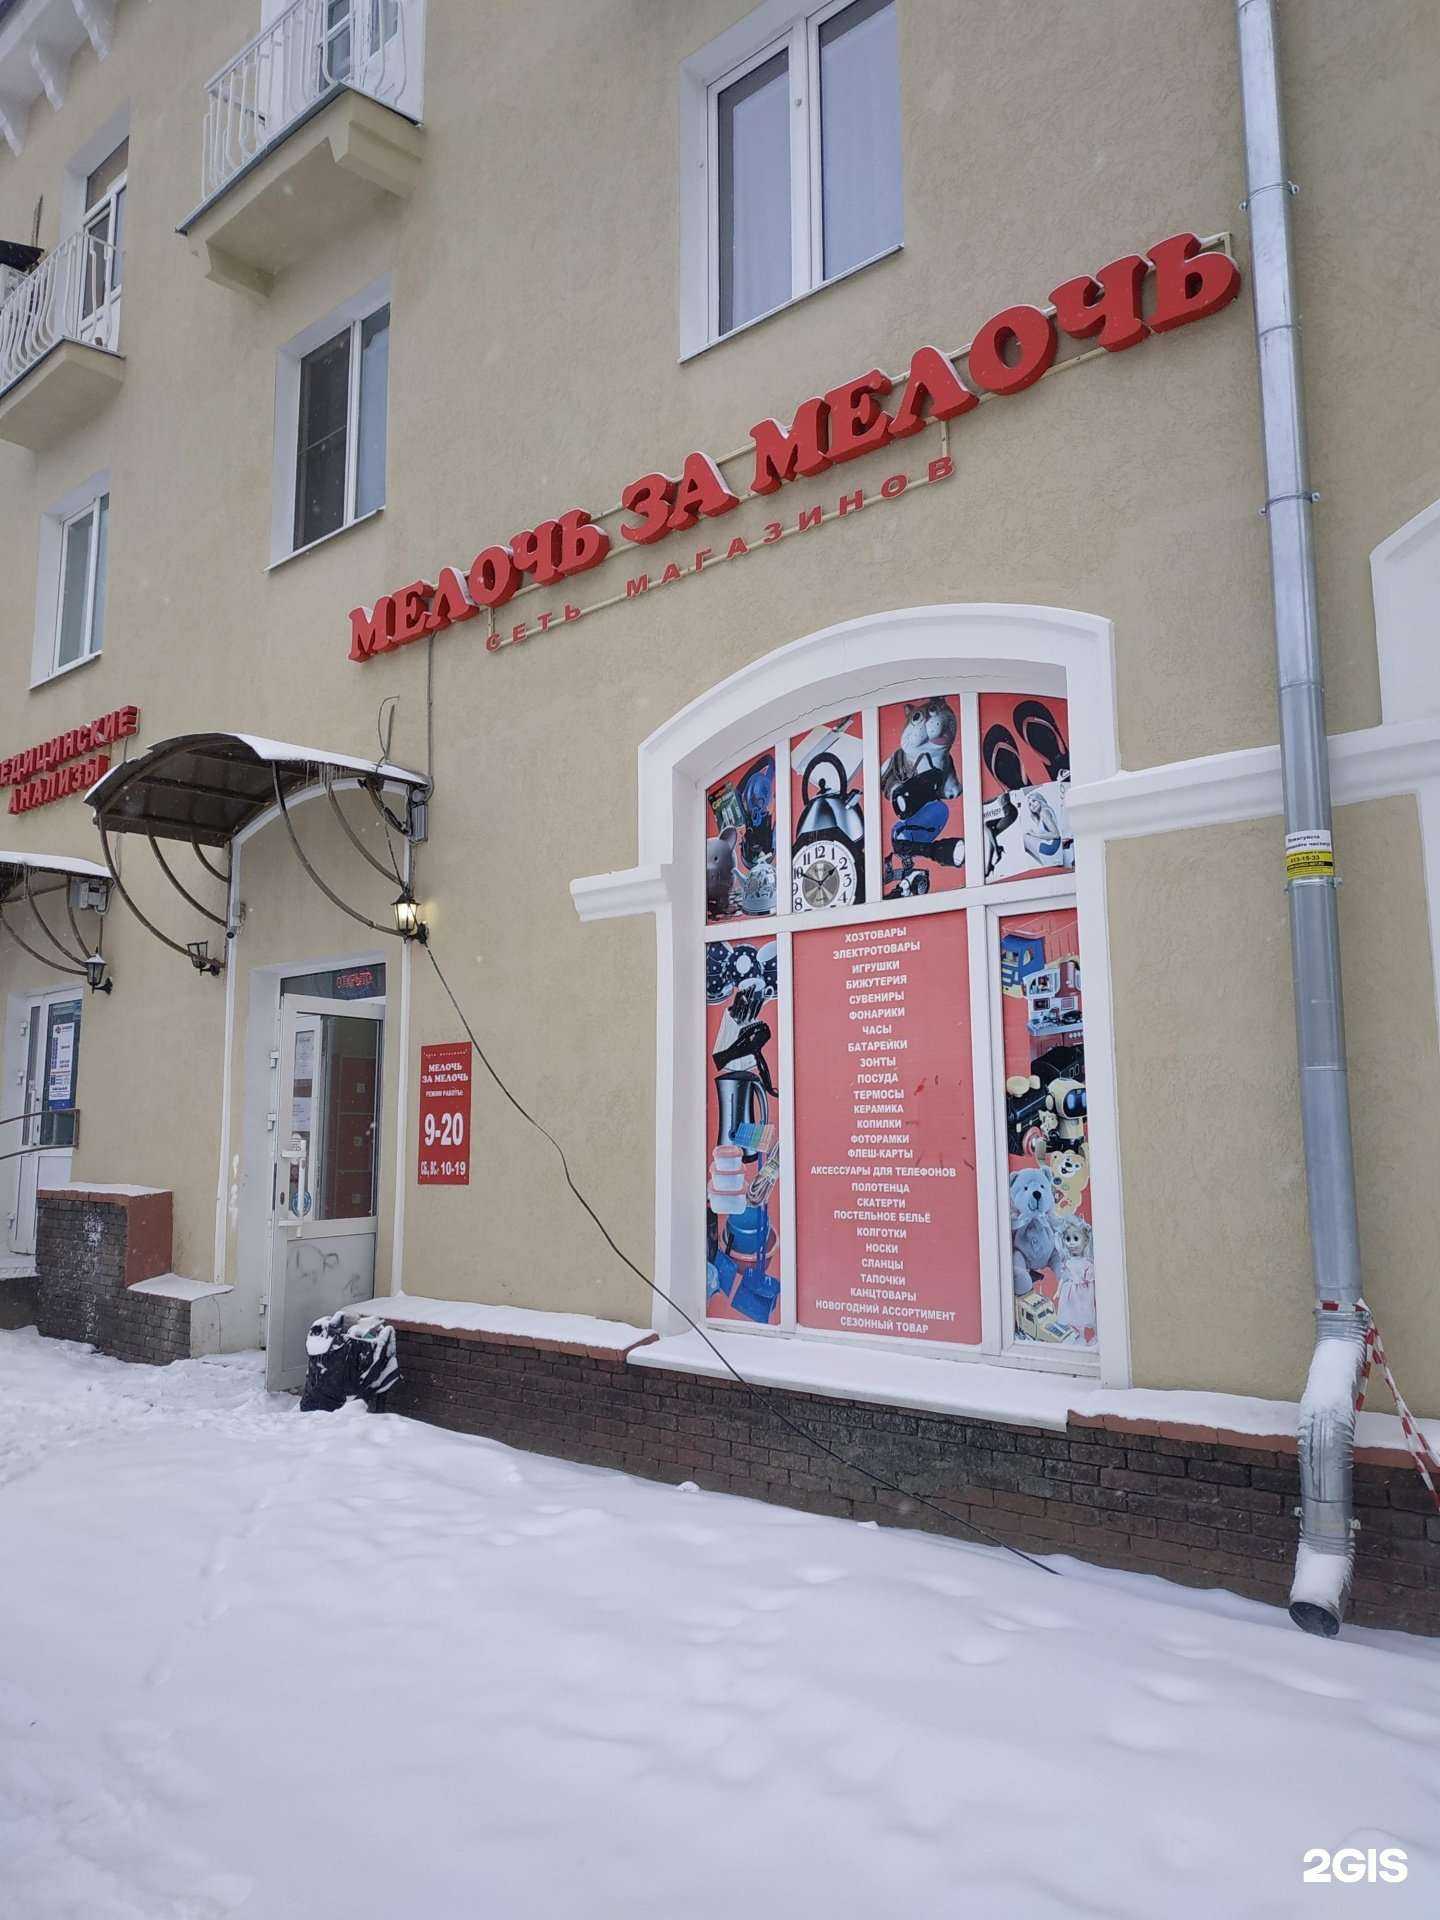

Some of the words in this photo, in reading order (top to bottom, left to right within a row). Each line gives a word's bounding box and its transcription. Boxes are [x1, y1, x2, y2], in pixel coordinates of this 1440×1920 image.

[349, 507, 611, 663] МЕЛОЧЬ
[621, 451, 740, 545] ЗА
[750, 231, 1242, 496] МЕЛОЧЬ
[486, 603, 582, 652] СЕТЬ
[626, 456, 956, 598] МАГАЗИНОВ
[0, 705, 138, 787] ЕДИЦИНСКИЕ
[8, 754, 111, 815] АНАЛИЗЫ
[816, 846, 825, 858] 12
[838, 857, 848, 870] 2
[843, 874, 852, 887] 3
[795, 897, 803, 911] 8
[845, 927, 906, 943] ХОЗТОВАРЫ
[833, 941, 920, 959] ЭЛЕКТРОТОВАРЫ
[852, 960, 900, 974] ИГРУШКИ
[846, 975, 907, 989] БИЖУТЕРИЯ
[849, 991, 904, 1004] СУВЕНИРЫ
[849, 1007, 905, 1020] ФОНАРИКИ
[862, 1025, 892, 1035] ЧАСЫ
[848, 1038, 908, 1052] БАТАРЕЙКИ
[428, 1062, 462, 1073] МЕЛОЧЬ
[860, 1057, 896, 1067] ЗОНТЫ
[421, 1075, 433, 1083] ЗА
[434, 1073, 469, 1082] МЕЛОЧЬ
[858, 1073, 898, 1084] ПОСУДА
[854, 1089, 904, 1100] ТЕРМОСЫ
[854, 1104, 904, 1114] КЕРАМИКА
[424, 1113, 464, 1146] 9-20
[857, 1120, 901, 1128] КОПИЛКИ
[851, 1135, 909, 1143] ФОТОРАМКИ
[848, 1149, 913, 1158] ФЛЕШ-КАРТЫ
[441, 1161, 466, 1176] 10-19
[811, 1166, 870, 1175] АКСЕССУАРЫ
[873, 1167, 892, 1177] ДЛЯ
[896, 1167, 956, 1177] ТЕЛЕФОНОВ
[852, 1183, 909, 1194] ПОЛОТЕНЦА
[857, 1198, 906, 1208] СКАТЕРТИ
[834, 1210, 896, 1222] ПОСТЕЛЬНОЕ
[856, 1227, 906, 1238] КОЛГОТКИ
[866, 1244, 898, 1253] НОСКИ
[862, 1258, 904, 1269] СЛАНЦЫ
[860, 1274, 906, 1285] ТАПОЧКИ
[850, 1288, 916, 1301] КАНЦТОВАРЫ
[816, 1300, 879, 1314] НОВОГОДНИЙ
[882, 1306, 956, 1321] АССОРТИМЕНТ
[840, 1316, 893, 1330] СЕЗОННЫЙ
[896, 1322, 928, 1333] ТОВАР
